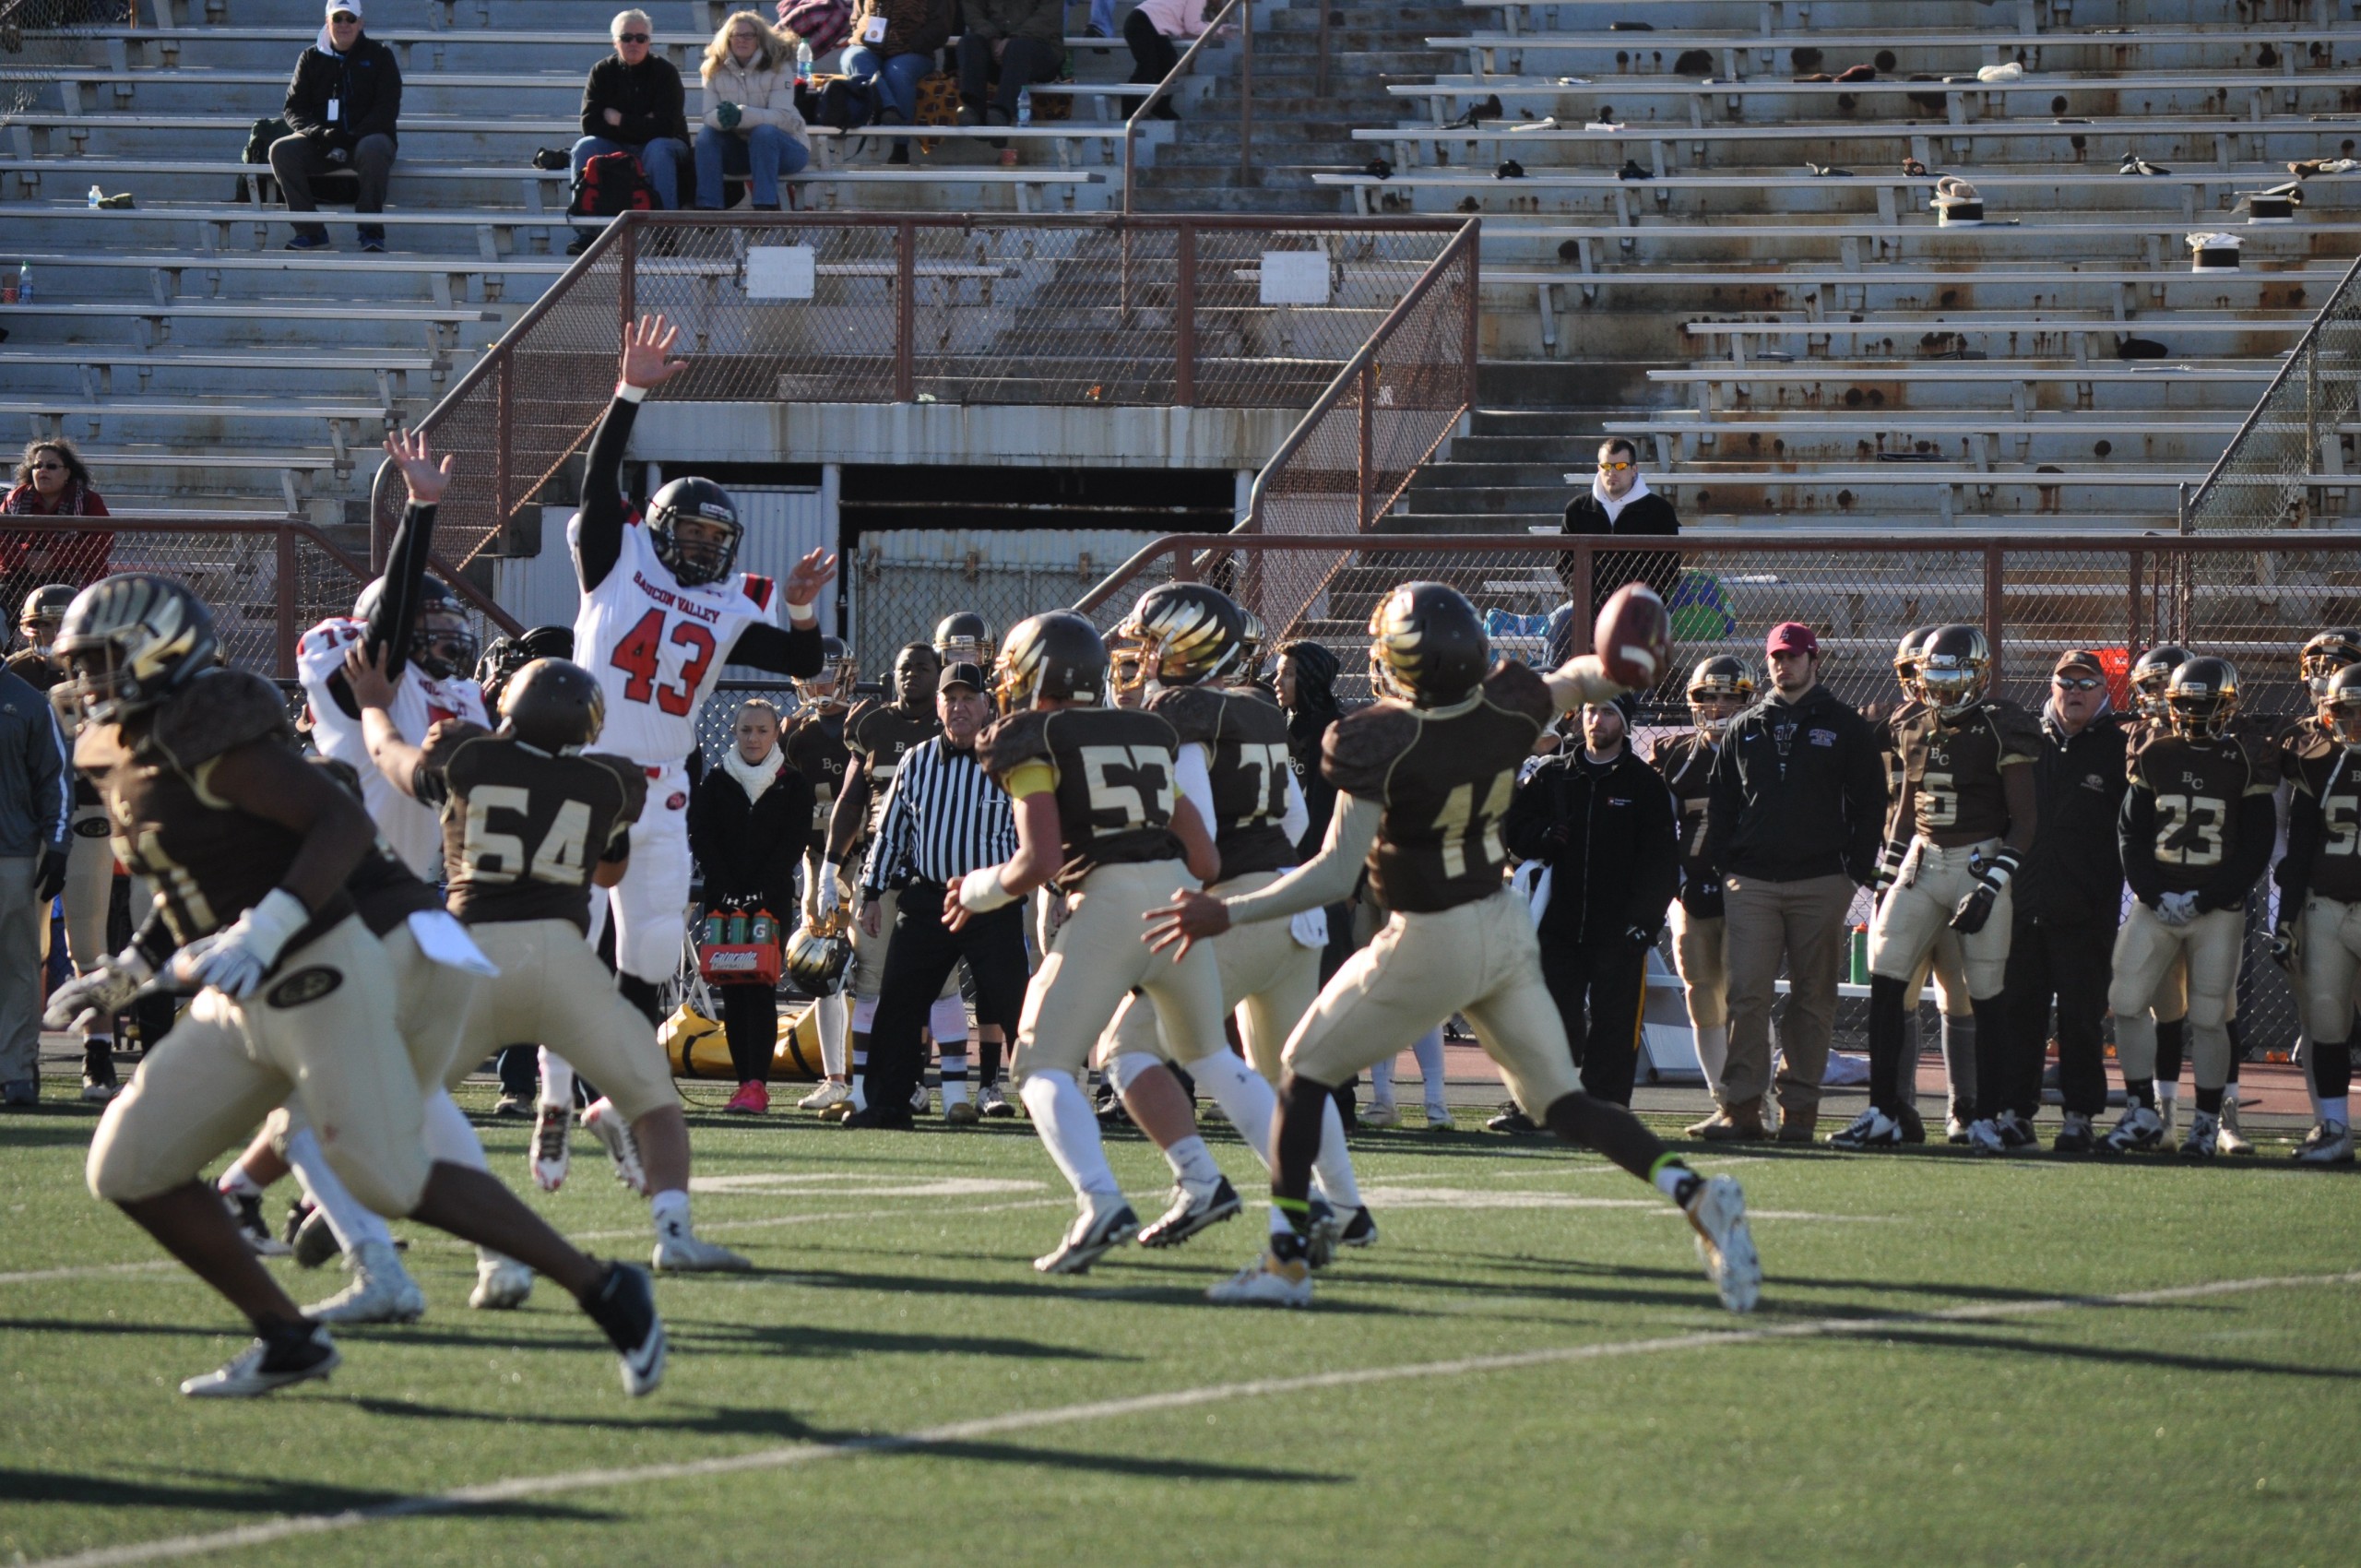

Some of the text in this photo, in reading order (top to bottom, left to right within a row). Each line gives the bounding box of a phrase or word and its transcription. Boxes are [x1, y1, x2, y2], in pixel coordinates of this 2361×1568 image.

[677, 596, 720, 624] VALLEY
[610, 607, 717, 717] 43
[822, 758, 843, 775] BC
[1930, 747, 1950, 766] BC
[2182, 771, 2204, 790] BC
[462, 784, 591, 886] 64
[1431, 767, 1515, 879] 11
[2154, 794, 2226, 865] 23
[2325, 795, 2361, 856] 5
[753, 924, 765, 938] G
[709, 951, 757, 964] Gatorade
